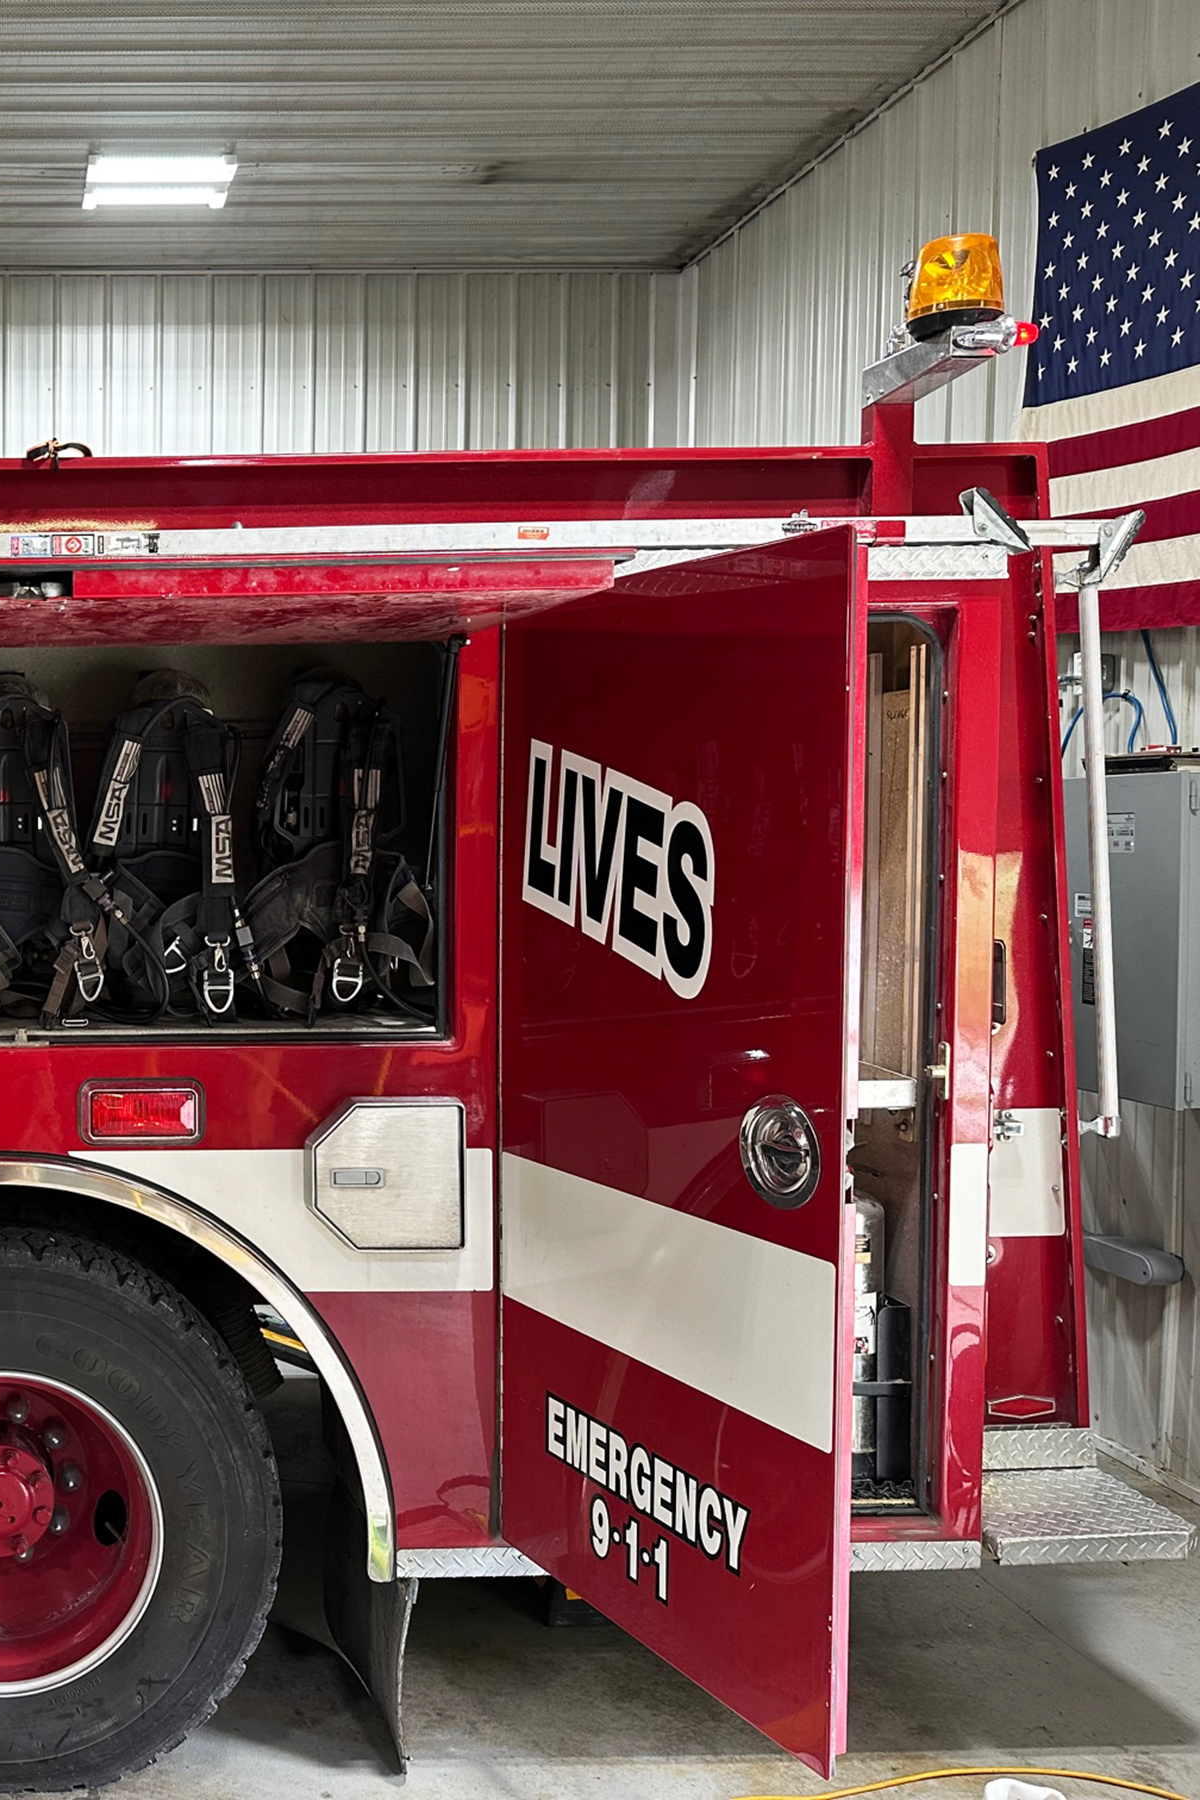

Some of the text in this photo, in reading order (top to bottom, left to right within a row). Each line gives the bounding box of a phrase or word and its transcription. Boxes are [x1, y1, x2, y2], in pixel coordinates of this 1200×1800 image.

[99, 783, 128, 842] MSA
[353, 811, 373, 872] MSA
[212, 818, 233, 880] MSA
[523, 740, 714, 997] LIVES
[546, 1391, 750, 1576] EMERGENCY
